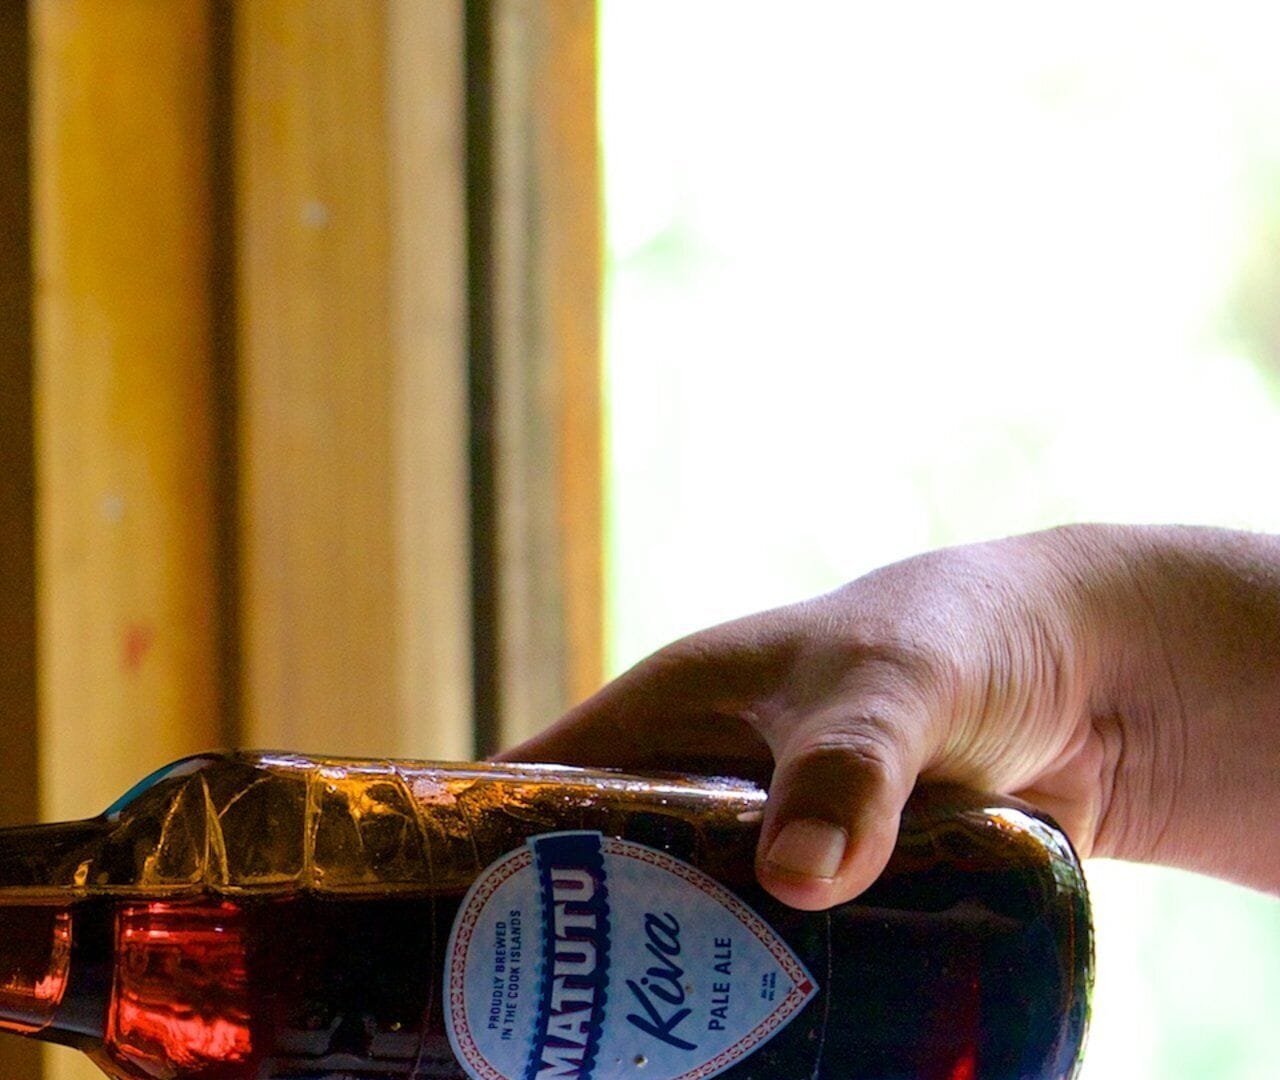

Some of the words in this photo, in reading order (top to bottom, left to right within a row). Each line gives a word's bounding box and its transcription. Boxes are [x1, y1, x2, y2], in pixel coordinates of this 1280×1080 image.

[496, 921, 507, 973] BREWED
[510, 910, 521, 962] ISLANDS
[714, 937, 732, 976] ALE
[488, 977, 505, 1029] PROUDLY
[508, 969, 520, 999] COOK
[626, 912, 698, 1050] Kiva
[504, 1003, 517, 1026] THE
[708, 983, 730, 1031] PALE
[501, 1029, 513, 1041] IN
